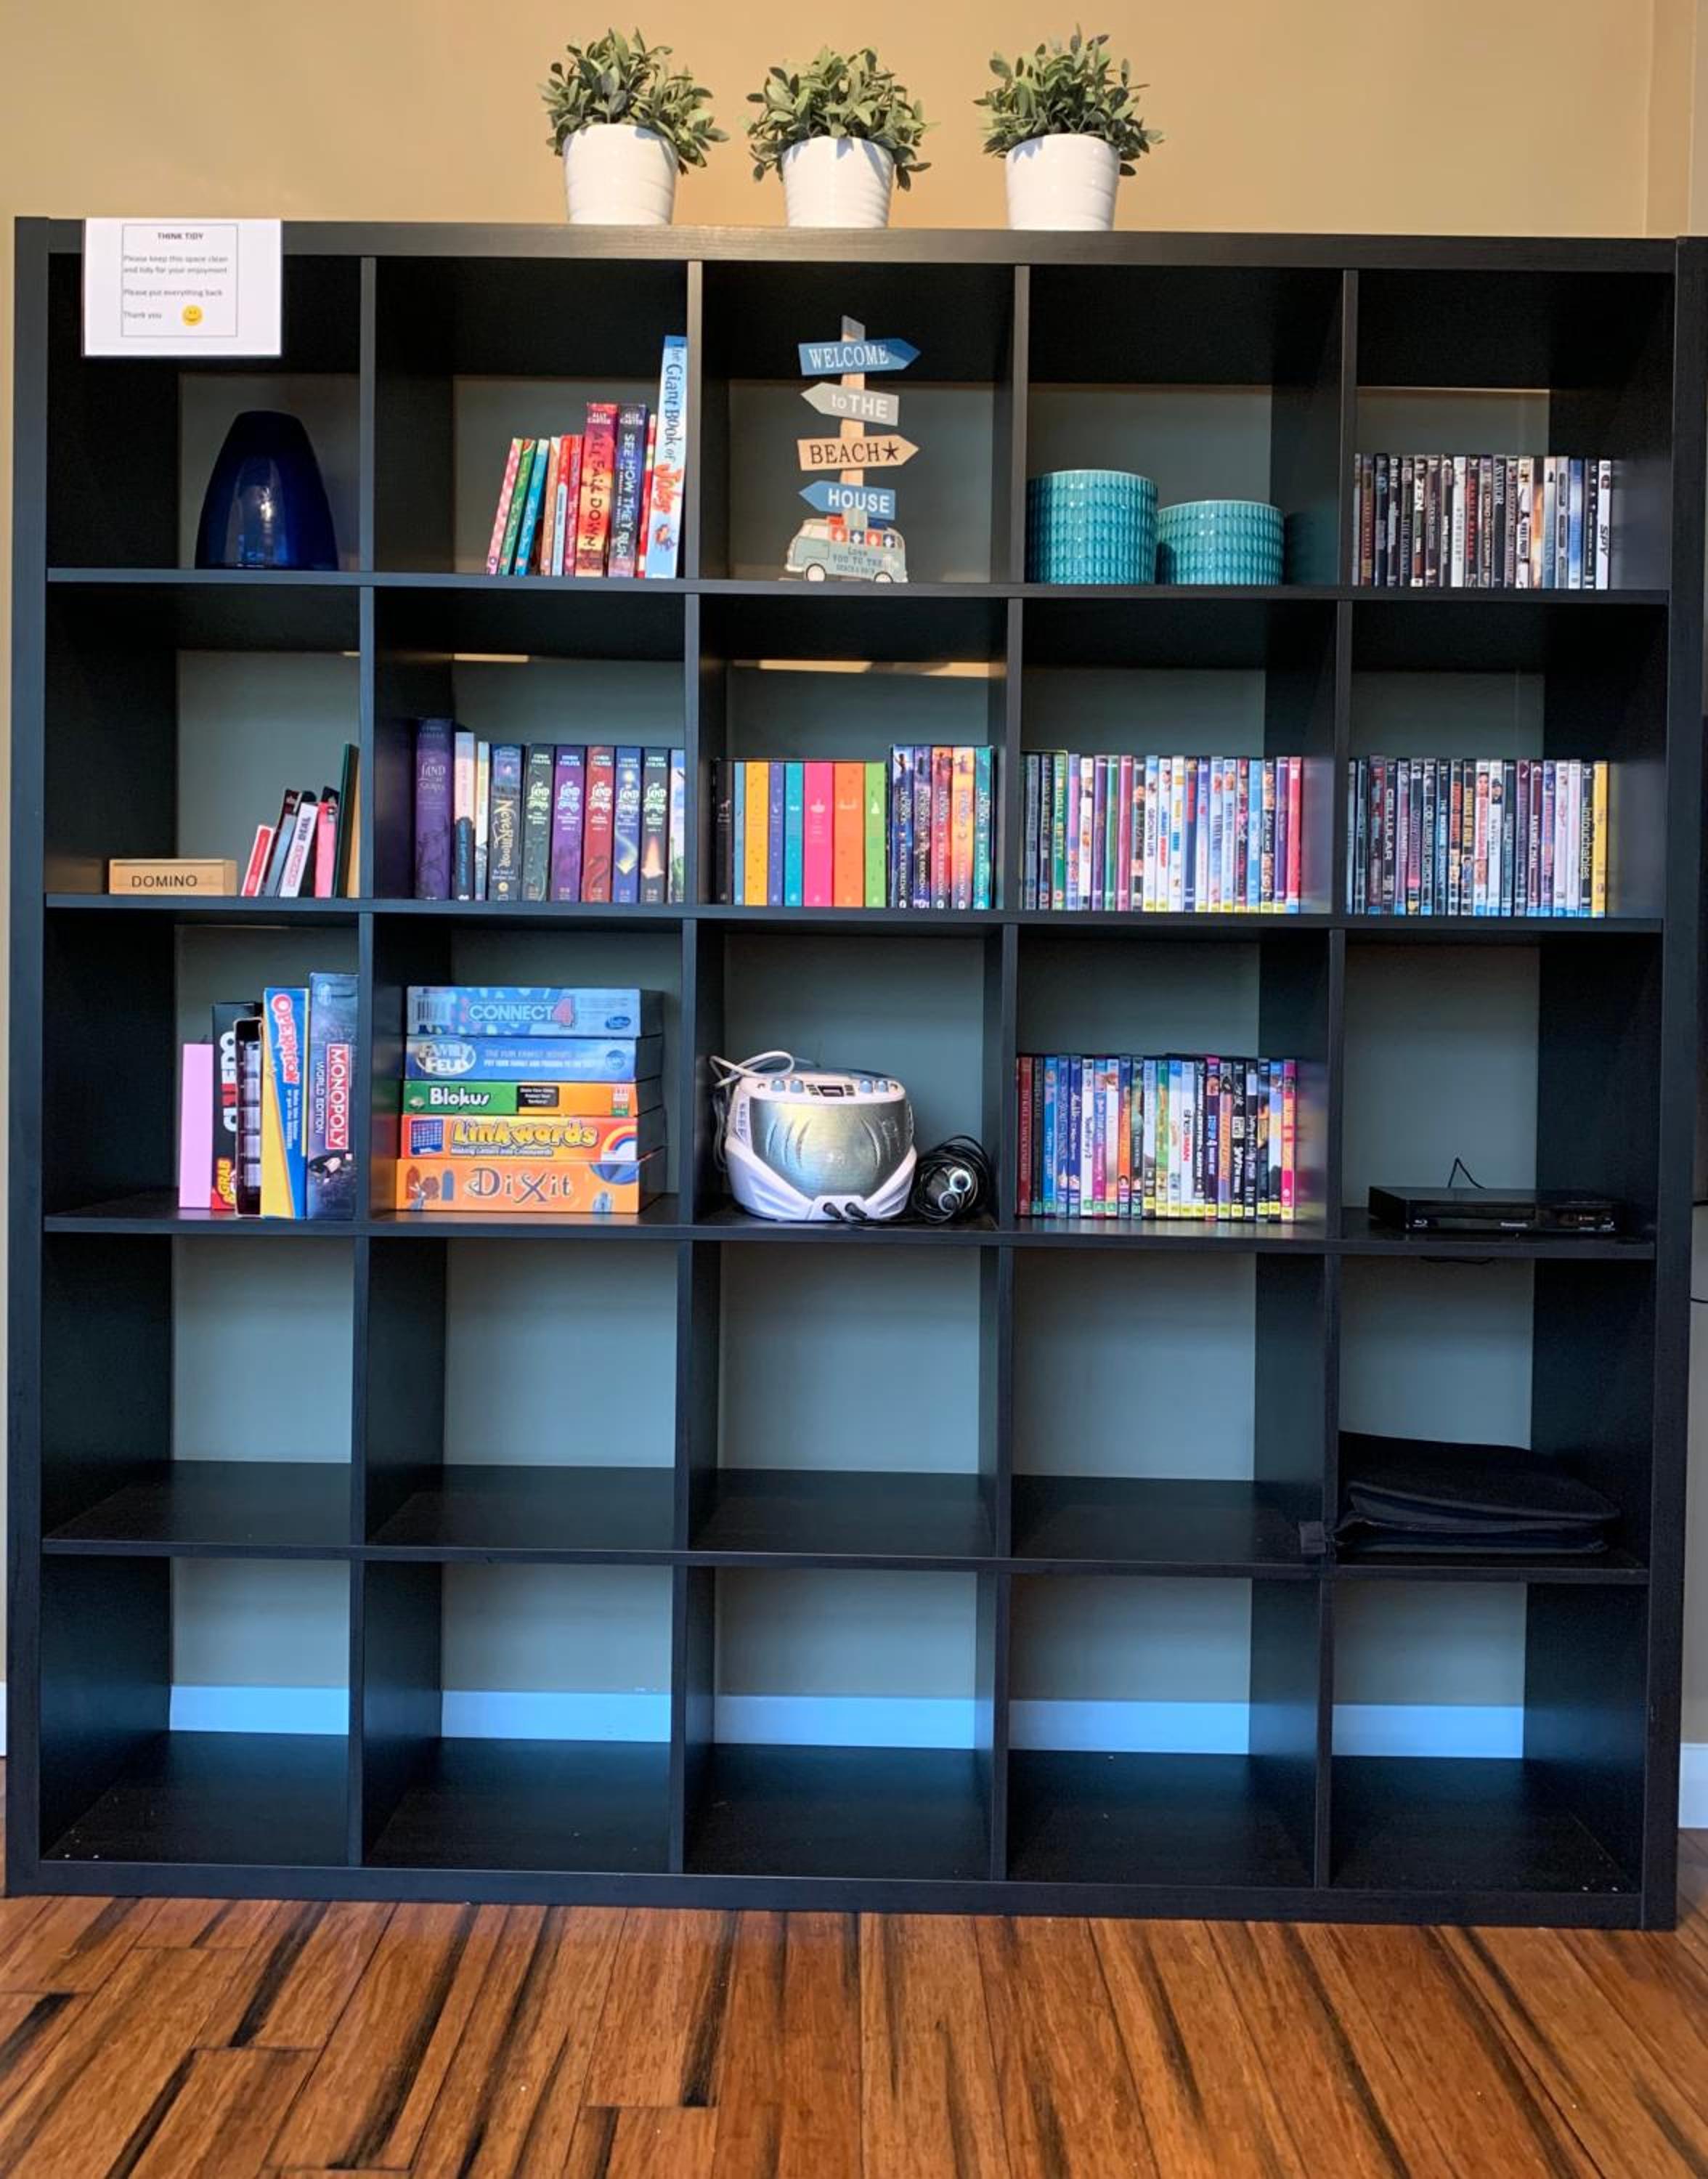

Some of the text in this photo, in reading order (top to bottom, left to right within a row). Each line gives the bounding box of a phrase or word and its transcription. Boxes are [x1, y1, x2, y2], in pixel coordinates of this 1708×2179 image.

[158, 232, 204, 240] THINK TIDY
[139, 266, 154, 275] tidy
[187, 266, 227, 275] enjoyment
[150, 255, 167, 264] keep
[163, 289, 203, 298] everything
[672, 344, 685, 362] The
[808, 344, 890, 369] WELCOME
[664, 364, 683, 408] Giant
[831, 392, 889, 419] to THE
[664, 409, 681, 446] Book
[664, 448, 675, 462] of
[810, 442, 880, 464] BEACH
[584, 431, 606, 547] ALL FALL DOWN
[615, 433, 638, 559] SEE HOW THEY RUN
[828, 487, 890, 513] HOUSE
[1415, 478, 1424, 511] ZEN
[1599, 524, 1609, 556] SPY
[1056, 790, 1065, 817] UGLY
[298, 816, 311, 841] DEAL
[1146, 808, 1155, 858] GROWN UPS
[1385, 789, 1394, 860] CELLULAR
[1581, 807, 1592, 880] Intouchables
[131, 875, 198, 888] DOMINO
[469, 995, 574, 1029] CONNECT 4
[271, 994, 300, 1084] OPERATION
[419, 1044, 472, 1058] FAMILY
[425, 1057, 471, 1074] FEUD
[314, 1061, 325, 1134] WORLD EDITION
[329, 1047, 345, 1148] MONOPOLY
[430, 1087, 491, 1109] Blokus
[451, 1119, 598, 1149] Linkwords
[218, 1159, 232, 1195] GRAB
[463, 1166, 574, 1204] Dixit
